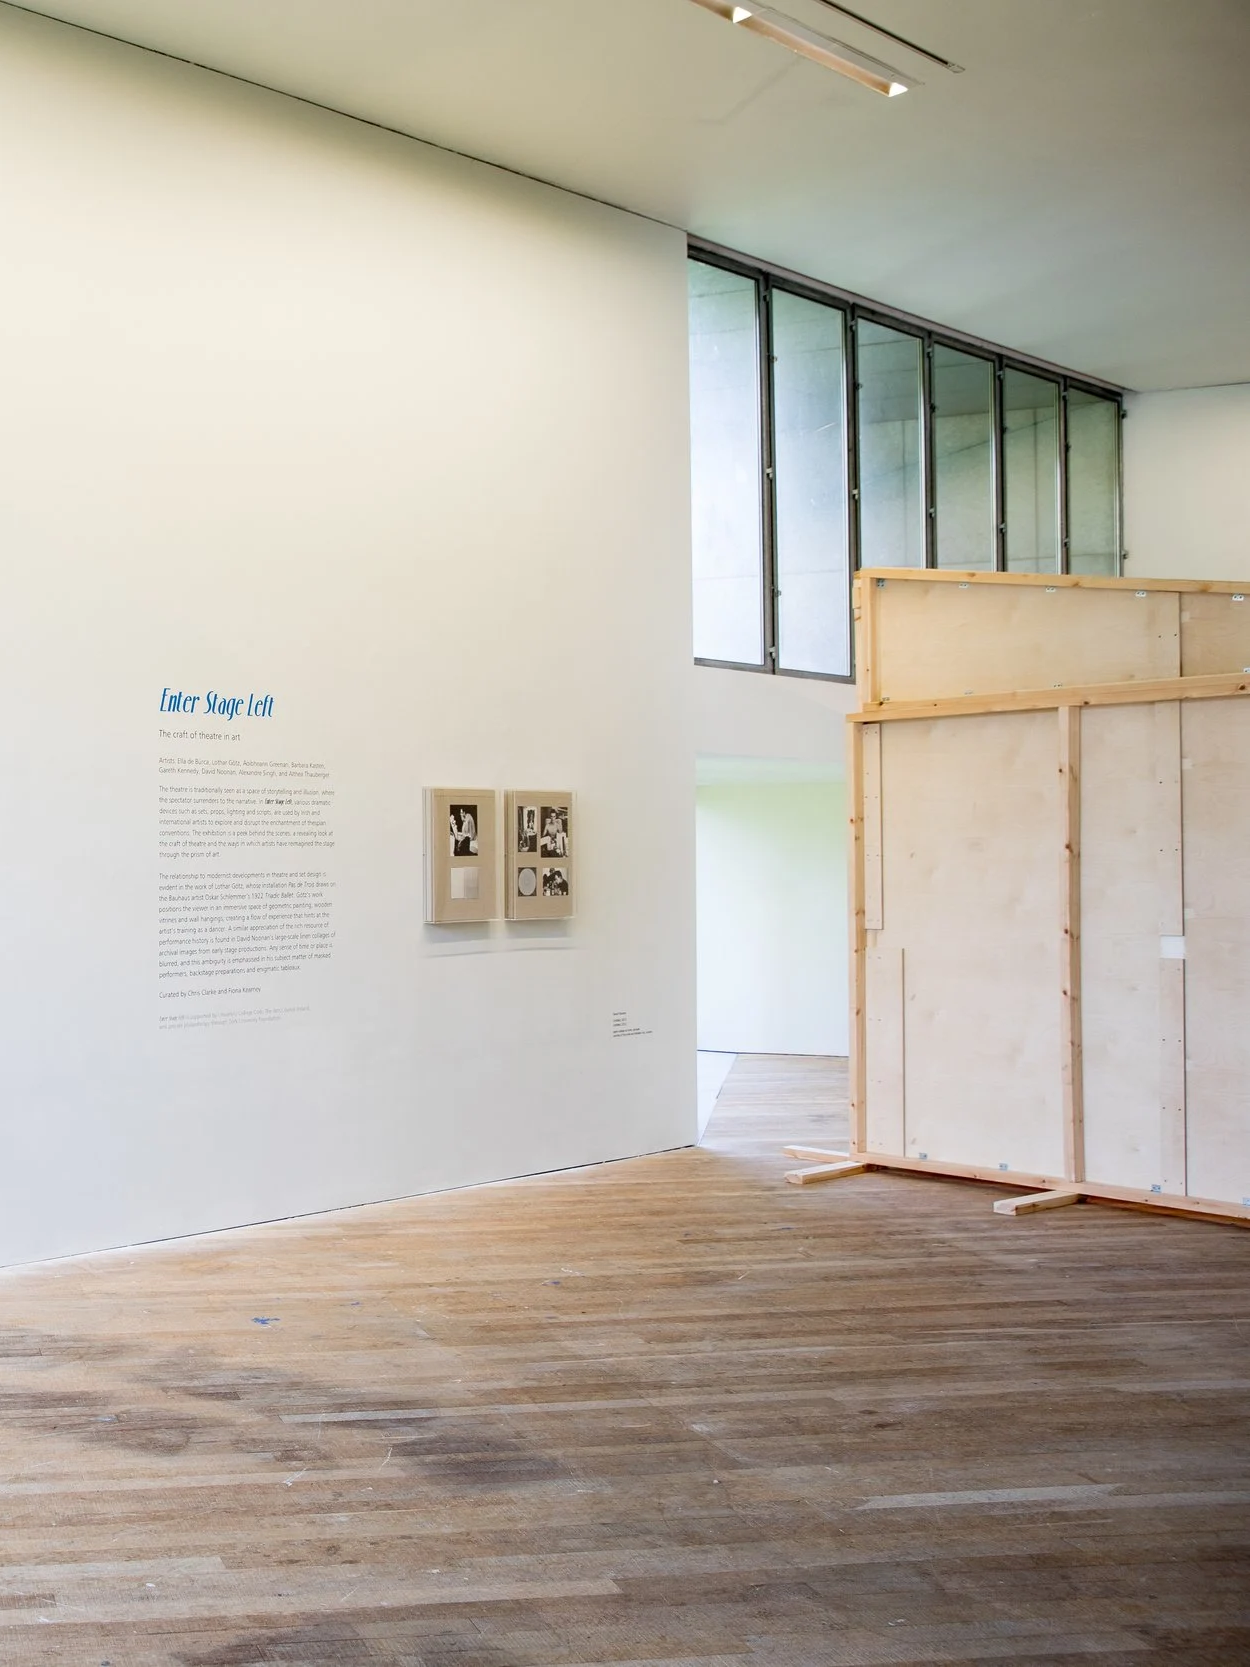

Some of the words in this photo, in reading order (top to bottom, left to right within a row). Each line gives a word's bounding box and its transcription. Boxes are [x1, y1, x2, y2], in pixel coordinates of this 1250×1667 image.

[160, 688, 200, 713] Enter
[203, 691, 244, 721] Stage
[247, 693, 274, 717] Left
[159, 730, 171, 738] The
[172, 730, 188, 739] craft
